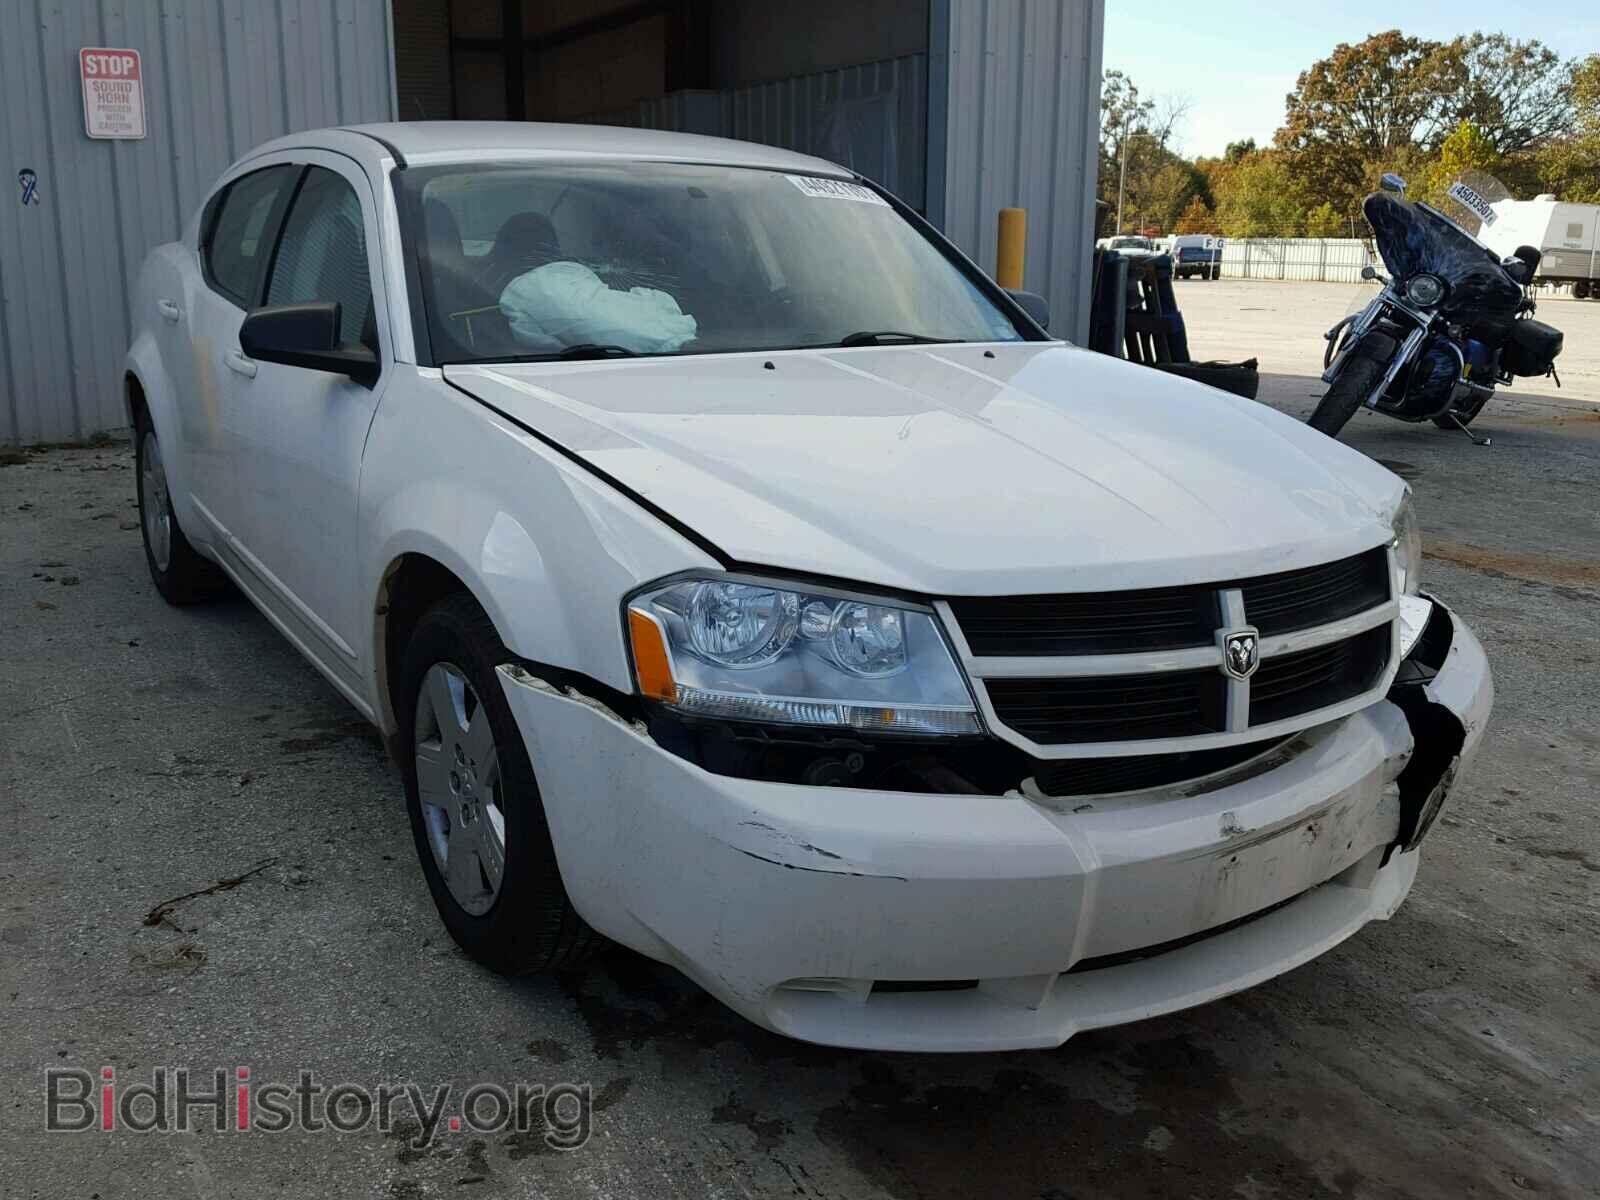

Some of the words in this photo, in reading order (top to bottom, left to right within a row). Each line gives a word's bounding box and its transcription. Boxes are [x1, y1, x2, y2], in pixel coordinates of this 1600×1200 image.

[86, 55, 134, 75] STOP
[92, 81, 132, 93] SOUND
[97, 92, 129, 104] HORN
[1206, 239, 1212, 248] F
